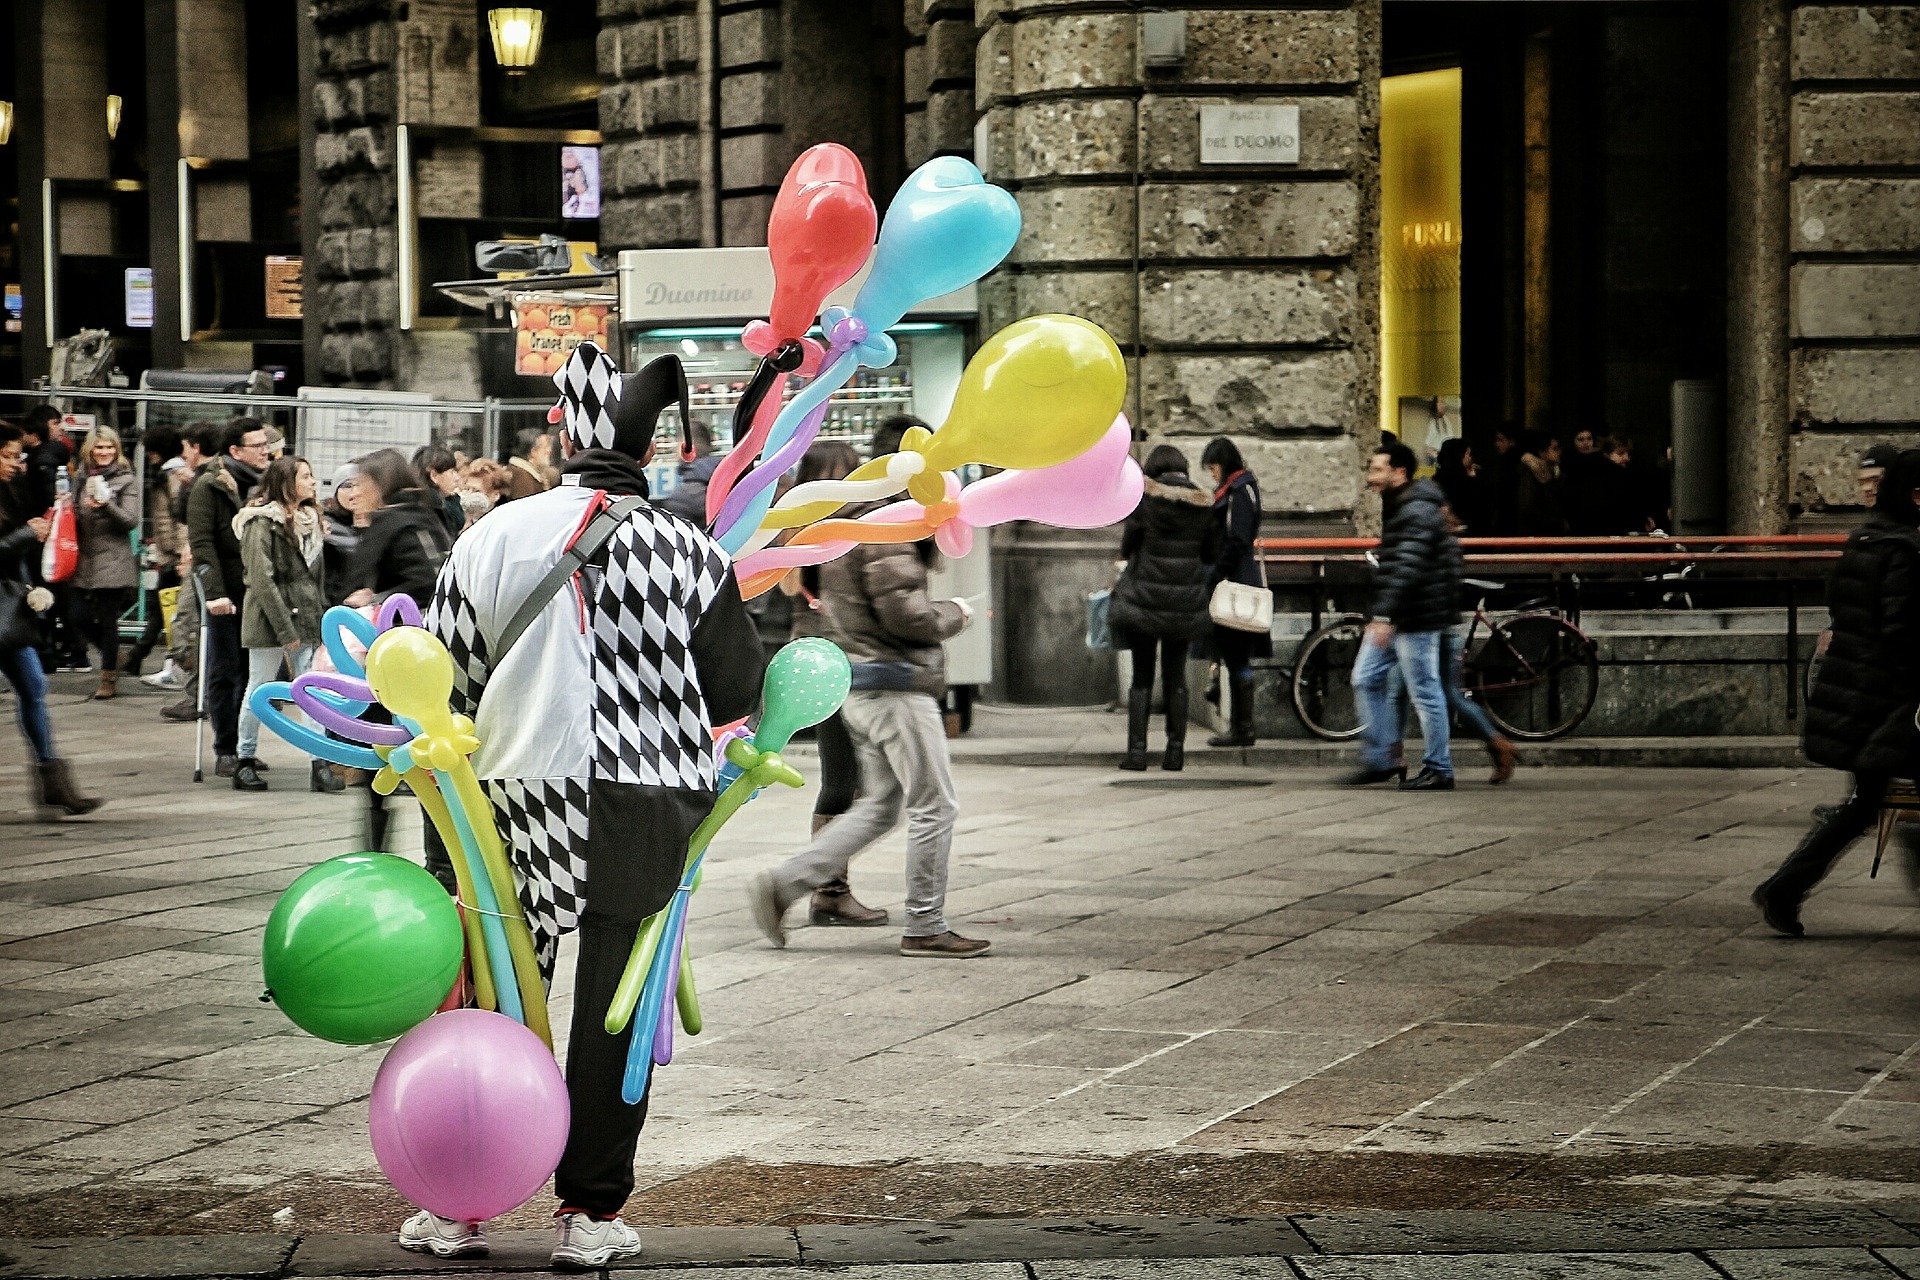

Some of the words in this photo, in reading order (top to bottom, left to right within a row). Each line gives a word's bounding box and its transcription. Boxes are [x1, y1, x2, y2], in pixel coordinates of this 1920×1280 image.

[1234, 134, 1295, 149] DUOMO
[1402, 221, 1462, 247] FURL
[644, 281, 753, 305] Duomino
